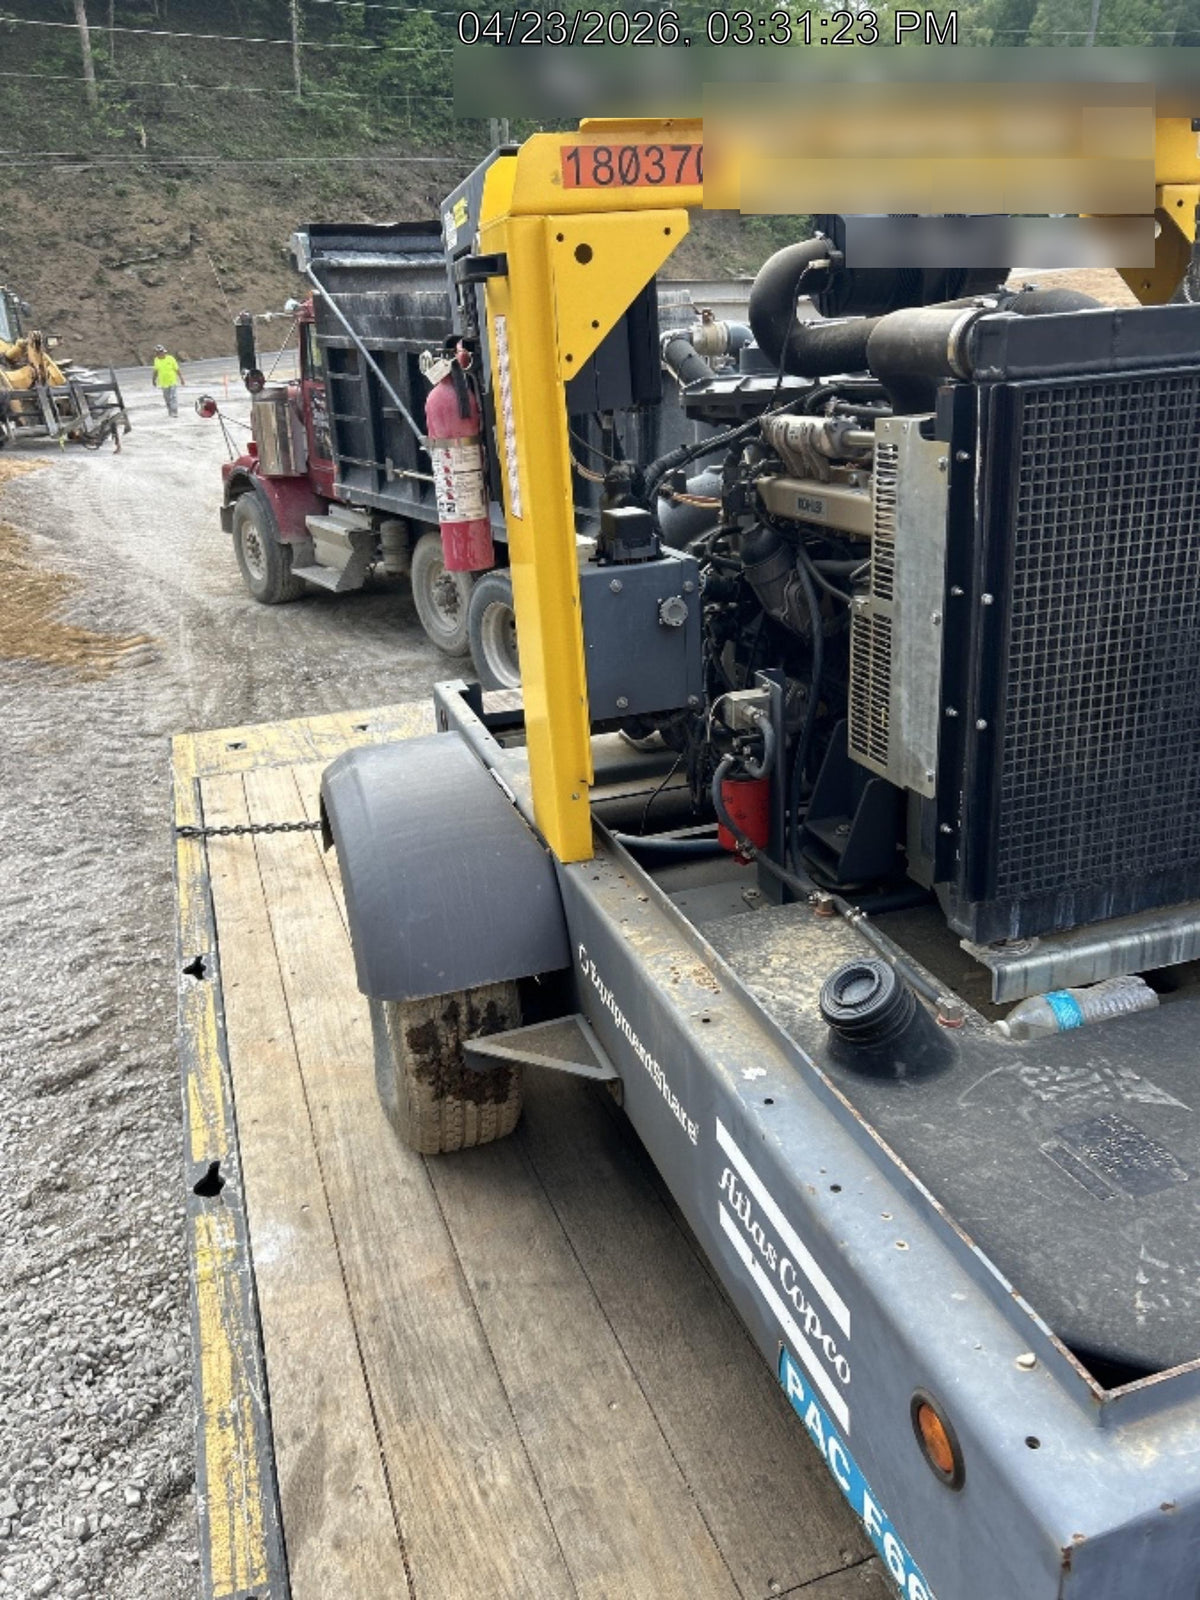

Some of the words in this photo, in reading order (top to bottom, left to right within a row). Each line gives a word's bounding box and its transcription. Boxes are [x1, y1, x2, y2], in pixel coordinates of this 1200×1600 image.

[566, 145, 703, 186] 18037
[718, 1167, 778, 1271] Atlas
[780, 1257, 851, 1385] Copco
[786, 1359, 851, 1492] PAC
